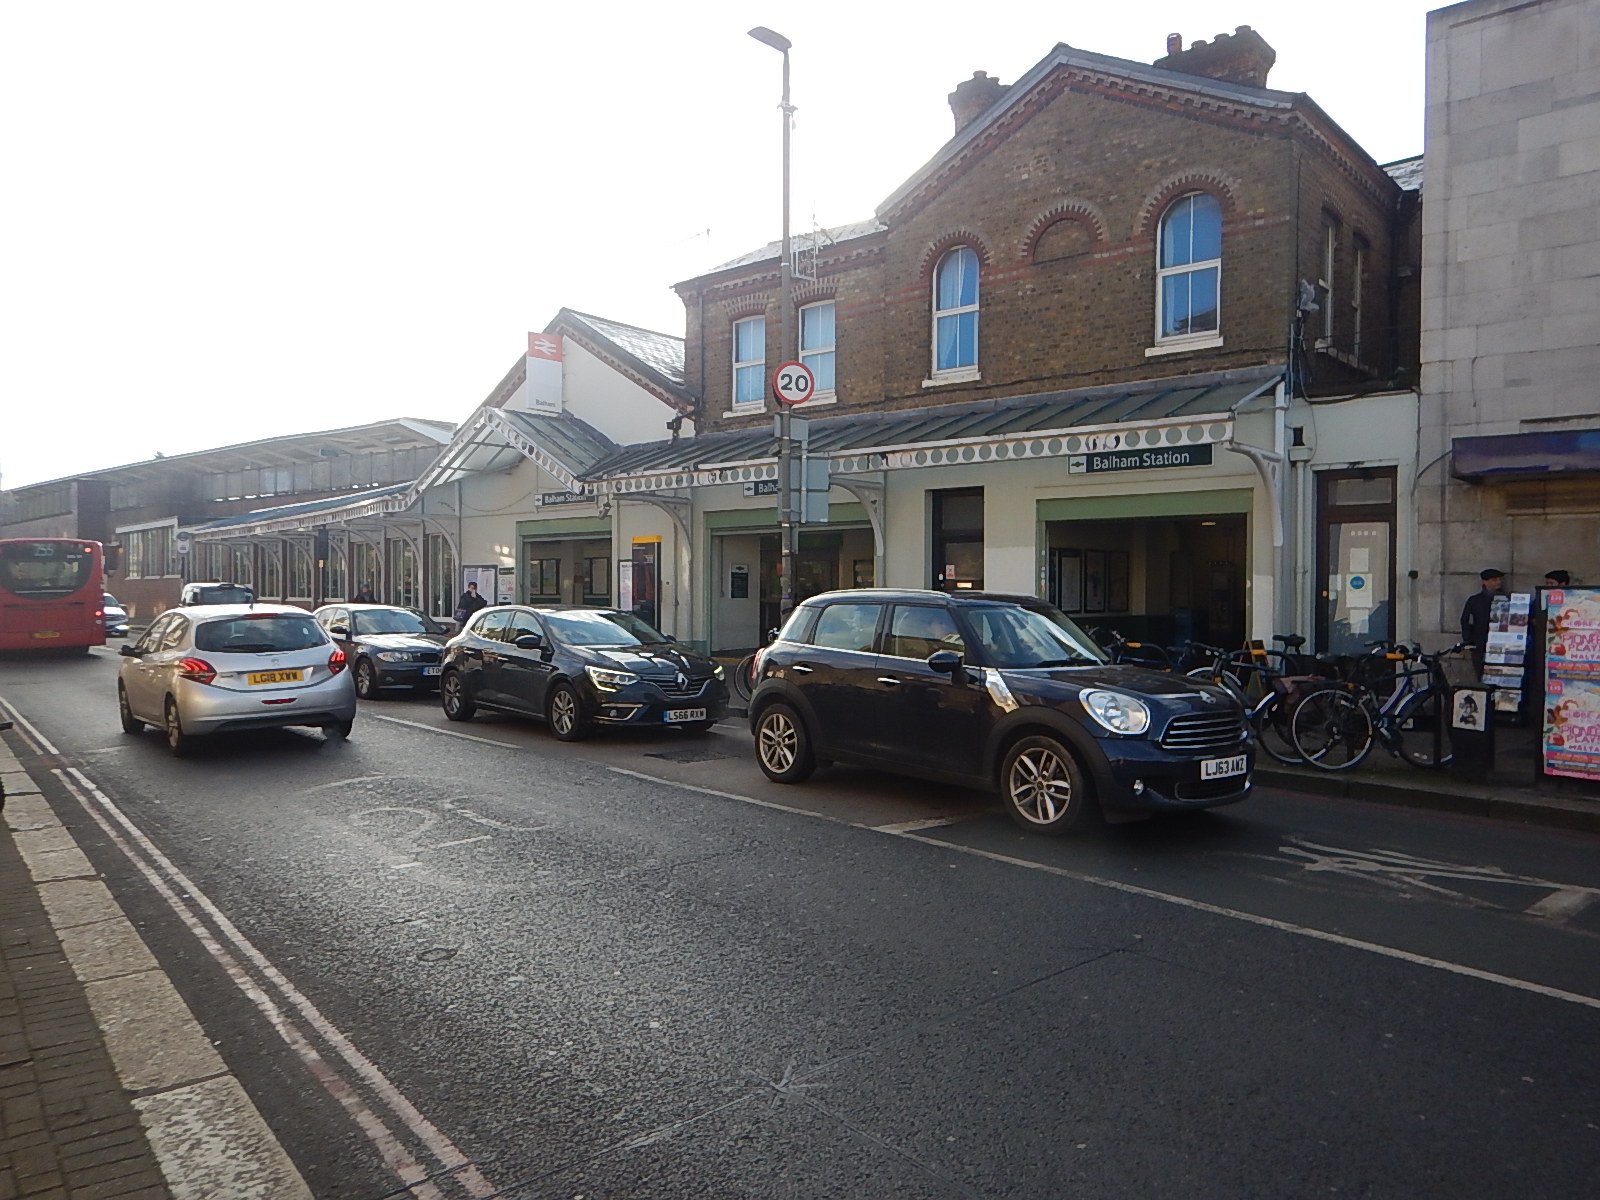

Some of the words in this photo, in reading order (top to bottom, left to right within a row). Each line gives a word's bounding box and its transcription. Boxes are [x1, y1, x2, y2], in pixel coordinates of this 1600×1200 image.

[780, 373, 809, 392] 20
[1093, 455, 1140, 470] Balham
[1142, 451, 1190, 466] Station
[758, 482, 778, 493] Balha
[544, 494, 566, 504] Balham
[668, 711, 689, 720] LS66
[1205, 760, 1230, 777] LJ63
